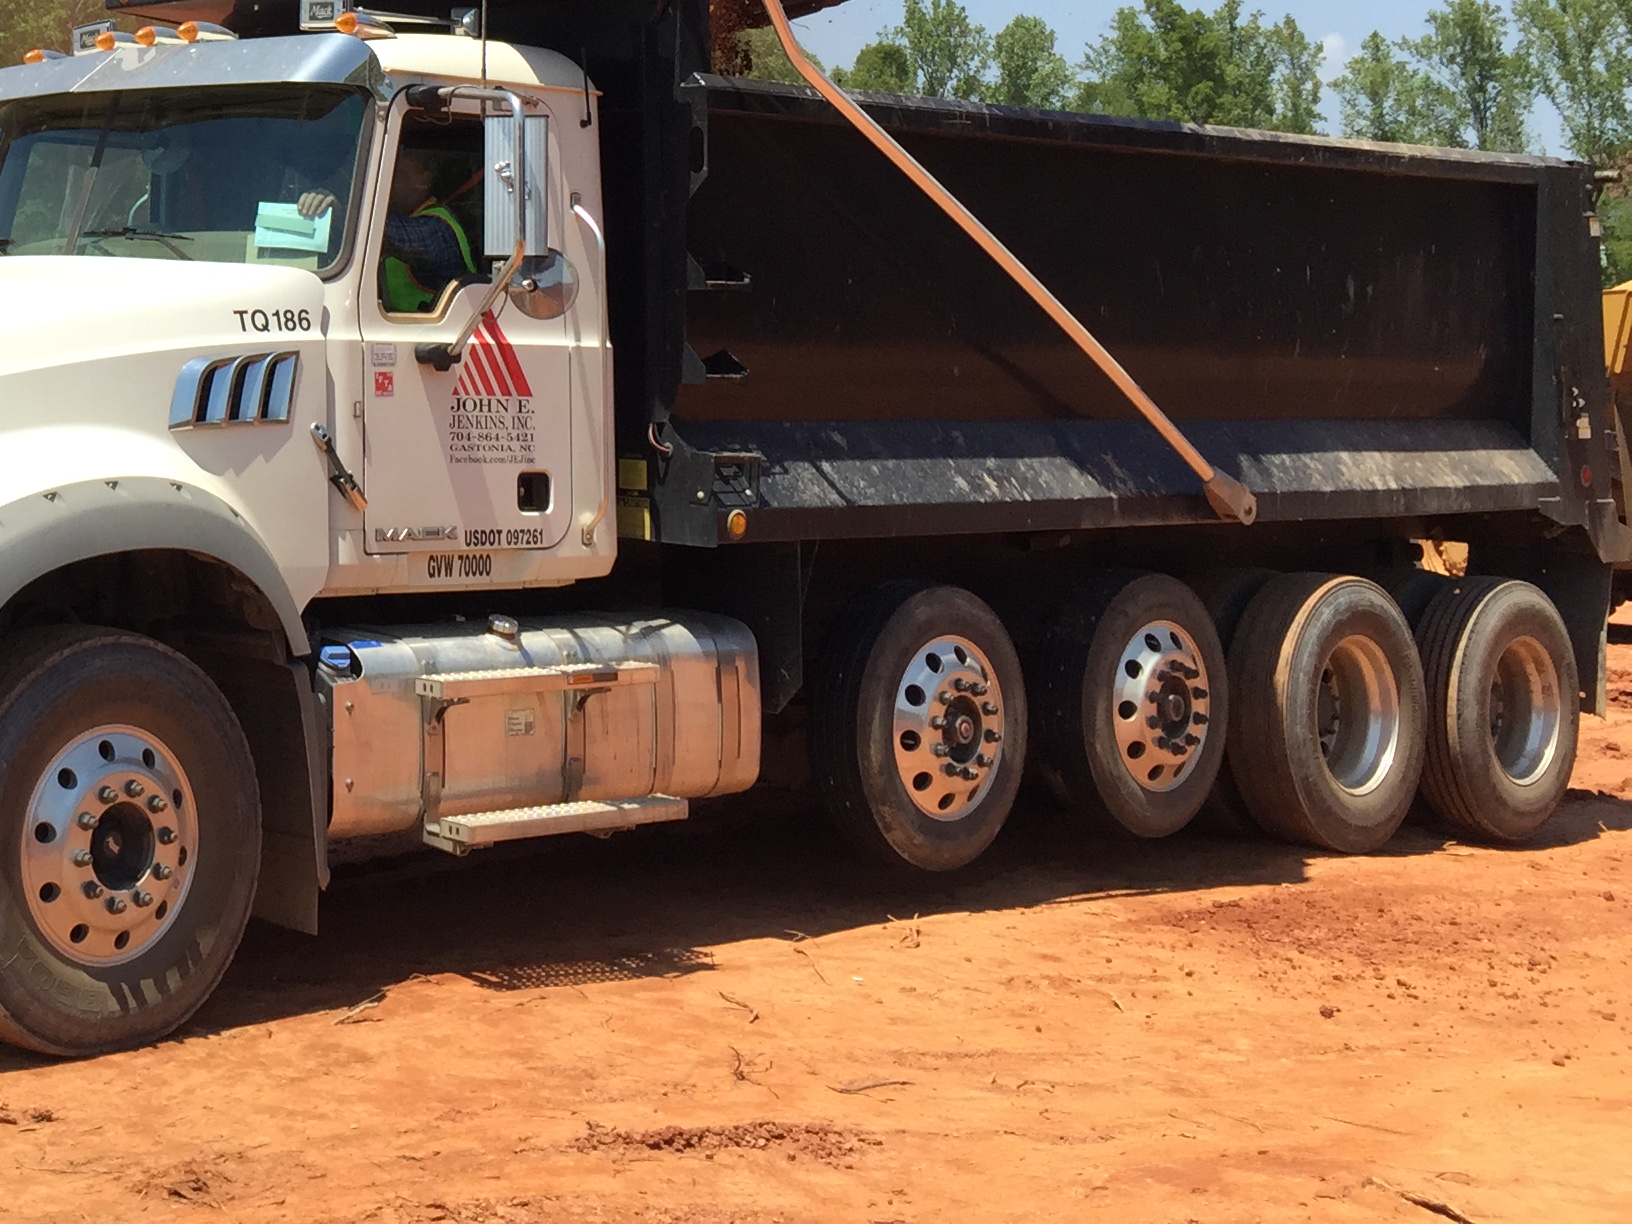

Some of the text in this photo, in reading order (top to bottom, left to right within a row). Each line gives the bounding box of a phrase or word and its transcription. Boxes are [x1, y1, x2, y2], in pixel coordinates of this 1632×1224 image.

[233, 308, 312, 333] TQ186
[450, 397, 536, 414] JOHN E.
[449, 414, 536, 431] JENKINS, INC.
[449, 431, 535, 443] 704-864-5421
[449, 443, 536, 453] GASTONIA, NC
[375, 526, 458, 543] MACK
[464, 528, 544, 547] USDOT 097261
[427, 553, 492, 579] GVW 70000
